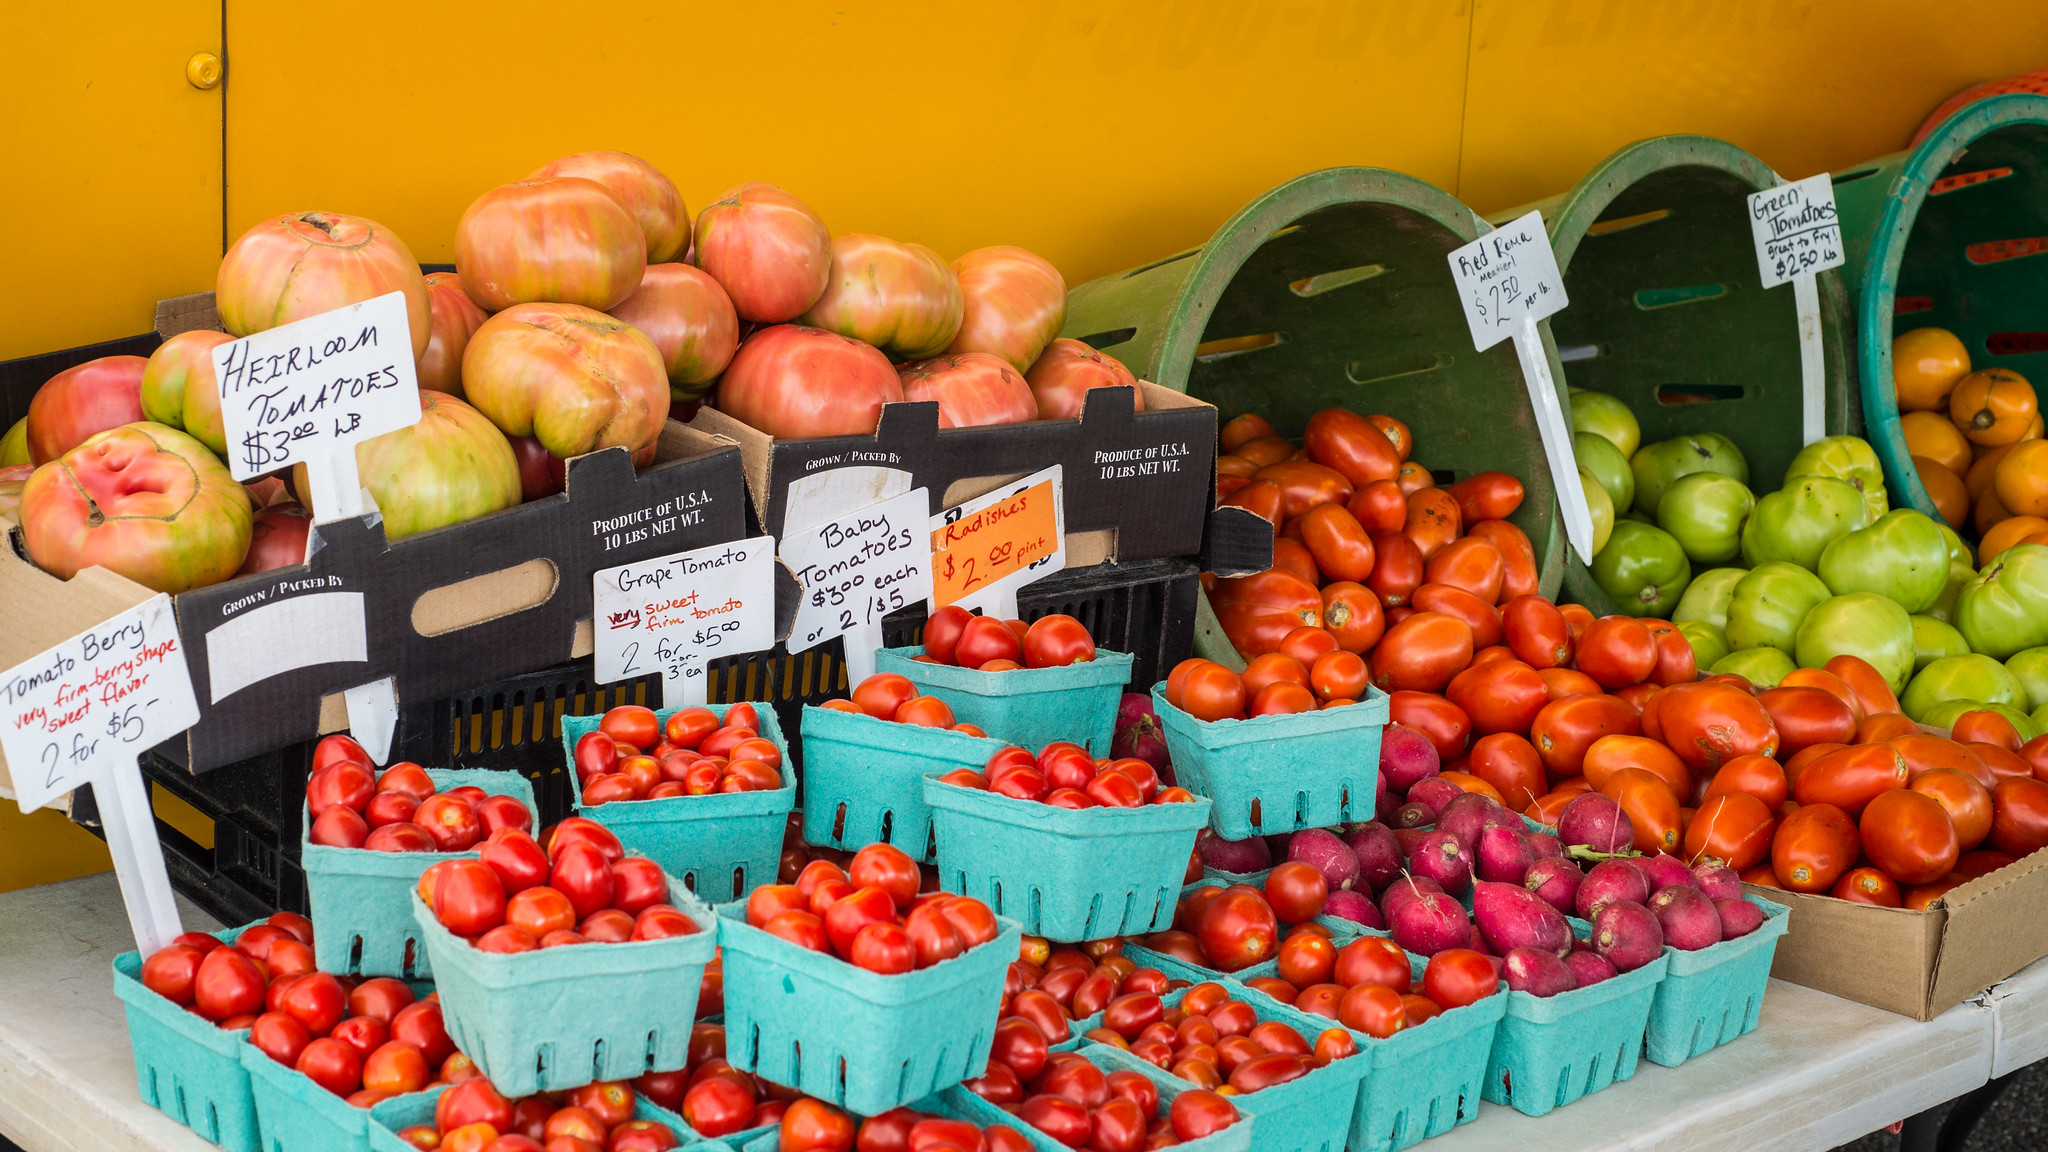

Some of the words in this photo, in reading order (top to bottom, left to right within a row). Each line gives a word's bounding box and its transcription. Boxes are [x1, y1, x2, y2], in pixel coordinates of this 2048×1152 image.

[1753, 188, 1799, 220] Green
[1767, 198, 1837, 239] Tomatoes
[1458, 242, 1488, 277] Red
[1768, 239, 1794, 260] great
[1797, 237, 1809, 248] to
[1524, 292, 1537, 309] per
[1538, 281, 1551, 295] lb.
[221, 326, 378, 398] HEIRLOOM
[248, 365, 398, 427] TOMATOES
[335, 413, 361, 437] LB
[843, 452, 850, 462] /
[1145, 447, 1158, 459] OF
[1161, 442, 1190, 457] U.S.A.
[1100, 466, 1114, 480] 10
[1117, 465, 1136, 478] LBS
[1138, 461, 1160, 476] NET
[1162, 459, 1180, 472] WT.
[657, 502, 672, 516] OF
[675, 490, 713, 511] U.S.A.
[604, 534, 621, 551] 10
[625, 529, 648, 545] LBS
[652, 517, 677, 537] NET
[680, 509, 705, 527] WT.
[820, 514, 890, 549] Baby
[945, 497, 1027, 547] Radishes
[797, 528, 912, 588] Tomatoes
[1017, 537, 1046, 564] pint
[618, 569, 673, 593] Grape
[669, 548, 747, 575] Tomato
[874, 564, 918, 589] each
[269, 585, 276, 598] /
[607, 609, 641, 629] very
[644, 590, 699, 615] sweet
[645, 614, 685, 632] firm
[690, 597, 743, 620] tomato
[807, 627, 823, 642] or
[0, 653, 74, 705] Tomato
[82, 620, 145, 661] Berry
[622, 641, 640, 674] 2
[654, 637, 682, 662] for
[686, 668, 702, 678] ea
[13, 707, 47, 730] very
[48, 697, 91, 733] sweet
[100, 674, 150, 707] flavor
[41, 743, 64, 789] 2
[69, 733, 99, 765] for
